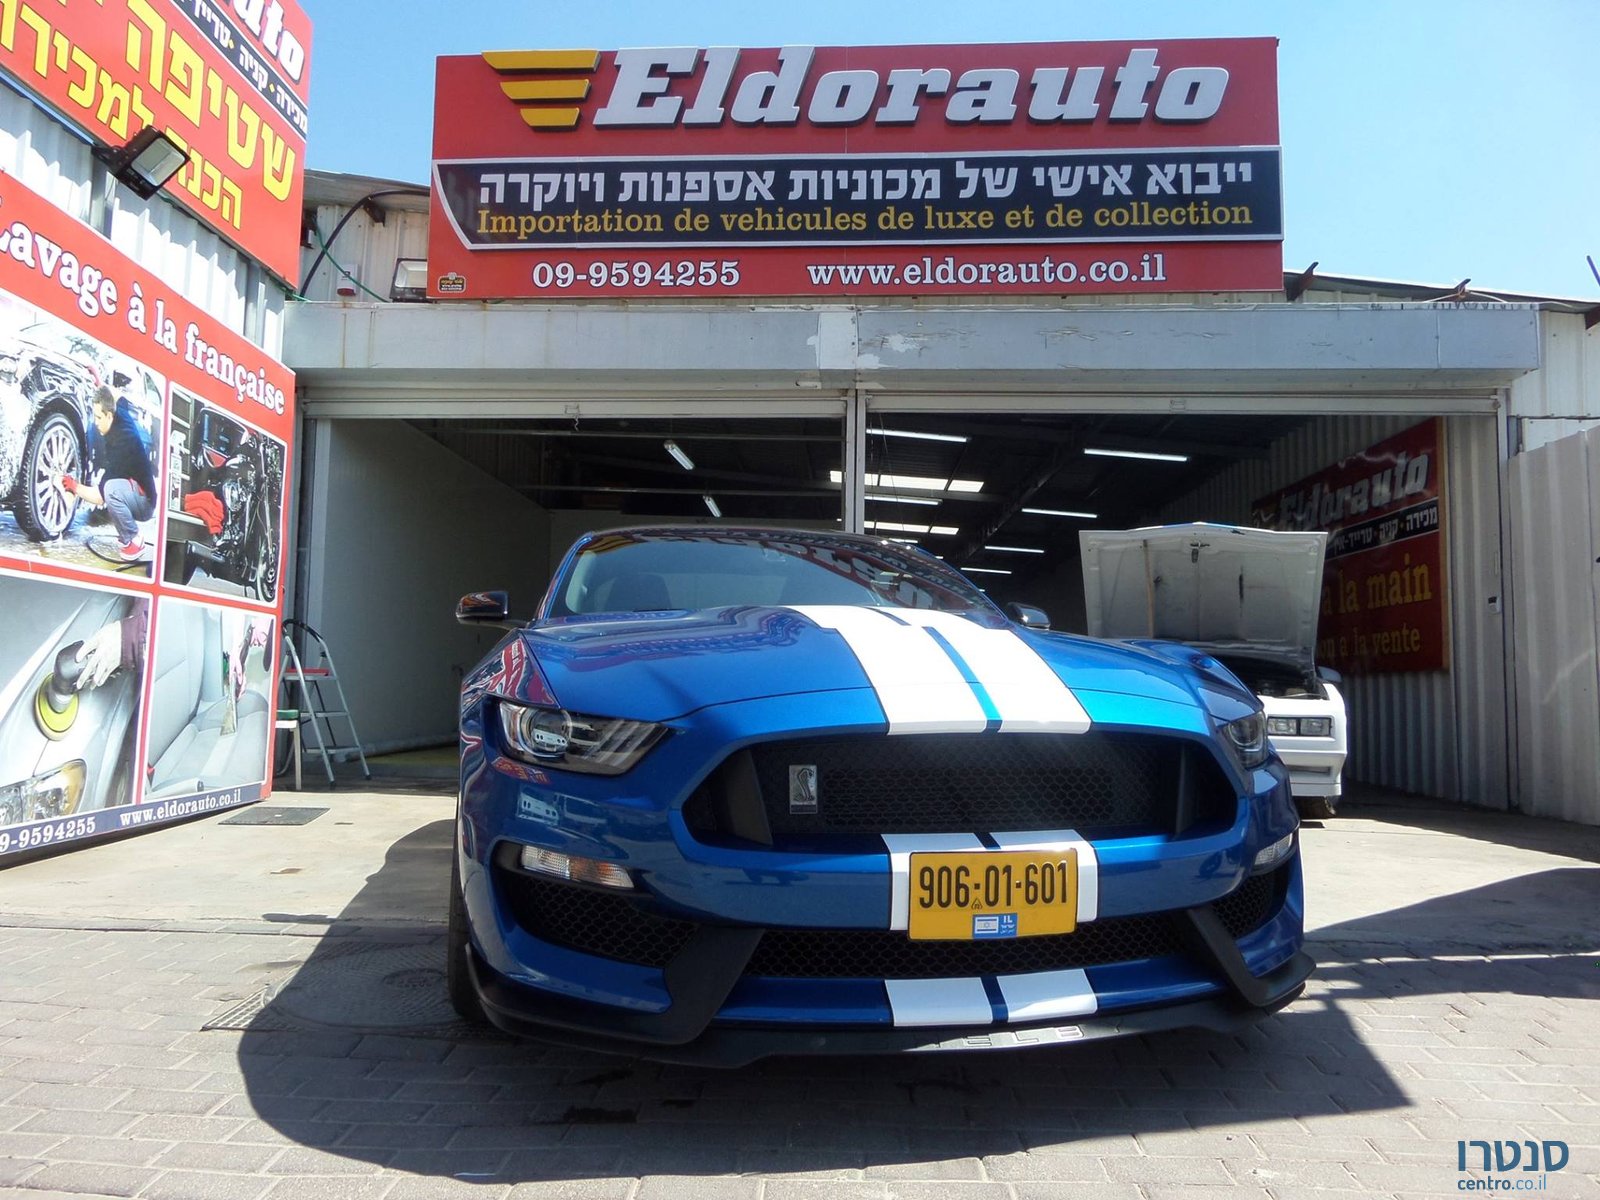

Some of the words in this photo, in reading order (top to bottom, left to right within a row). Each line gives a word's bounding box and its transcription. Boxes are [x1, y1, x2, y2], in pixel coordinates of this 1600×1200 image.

[125, 0, 296, 201] שטיפה
[593, 45, 1229, 125] Eldorauto
[479, 172, 605, 212] ויוקרה
[617, 170, 776, 203] אספנות
[788, 169, 941, 201] מכוניות
[956, 161, 1018, 199] של
[1032, 165, 1134, 198] אישי
[1146, 162, 1252, 196] ייבוא
[477, 208, 664, 240] Importation
[674, 208, 710, 232] de
[720, 206, 867, 231] vehicules
[877, 206, 914, 230] de
[925, 205, 994, 230] luxe
[1004, 204, 1034, 228] et
[1045, 203, 1083, 227] de
[1094, 201, 1253, 226] collection
[532, 260, 740, 288] 09-9594255
[807, 253, 1166, 285] www.eldorauto.co.il
[127, 281, 147, 334] à
[153, 299, 178, 354] la
[183, 322, 286, 416] française
[1366, 552, 1433, 610] main
[1373, 621, 1420, 656] vente
[119, 791, 242, 827] www.eldorauto.co.il
